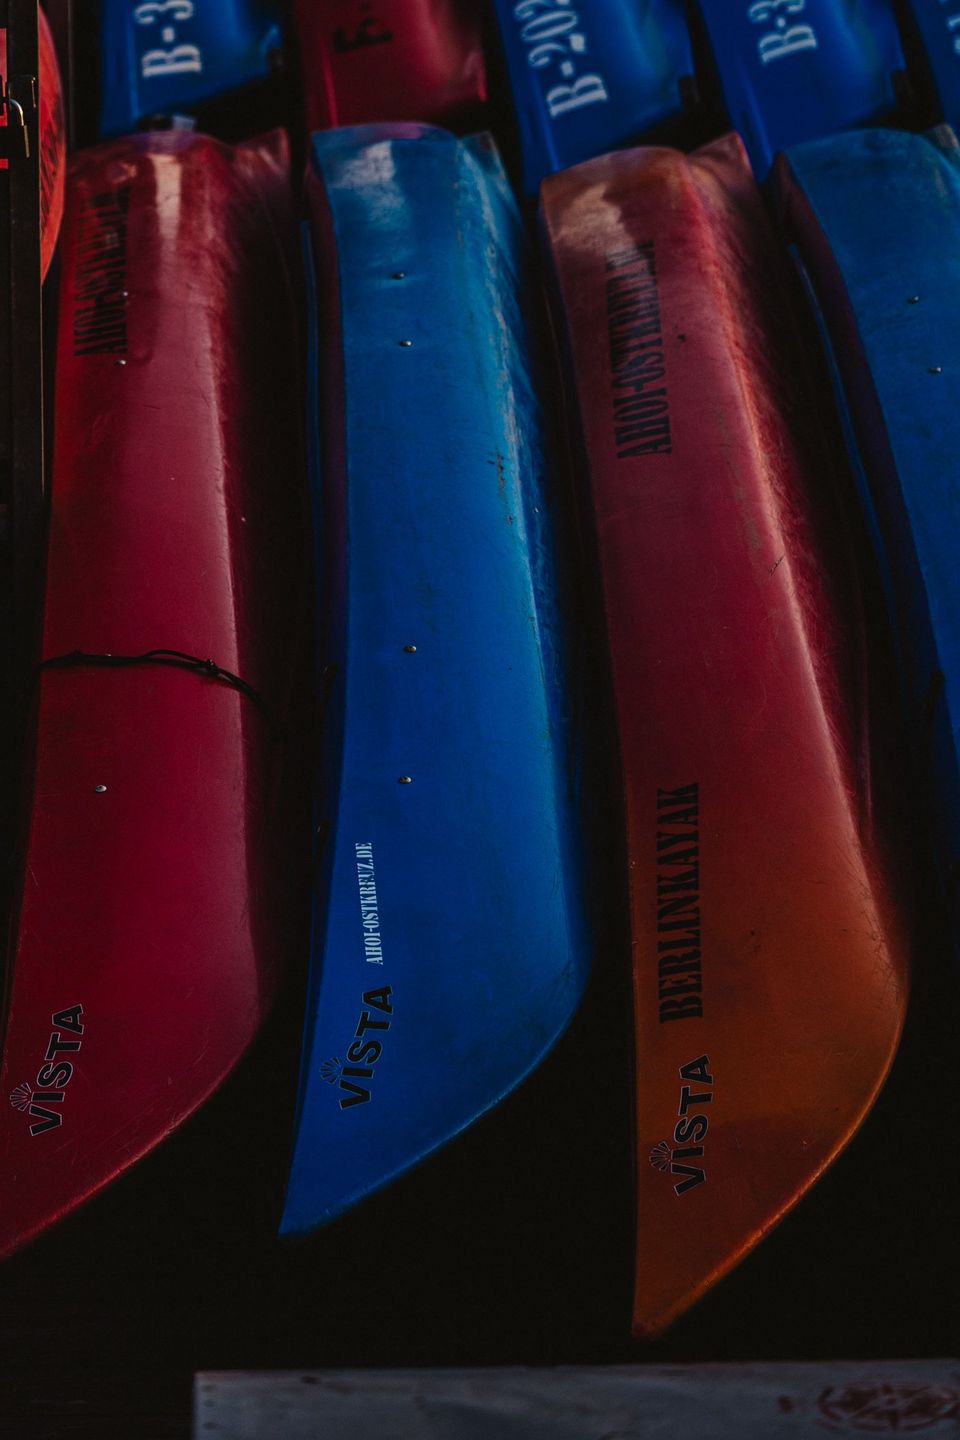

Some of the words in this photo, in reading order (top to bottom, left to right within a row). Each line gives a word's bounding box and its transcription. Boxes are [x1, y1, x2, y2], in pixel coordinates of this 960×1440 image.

[354, 841, 386, 966] AHOI-OSTKREUZ.DE
[656, 781, 704, 1024] BERLINKAYAK
[30, 1002, 86, 1138] VISTA
[339, 983, 395, 1110] VISTA
[671, 1053, 717, 1197] VISTA
